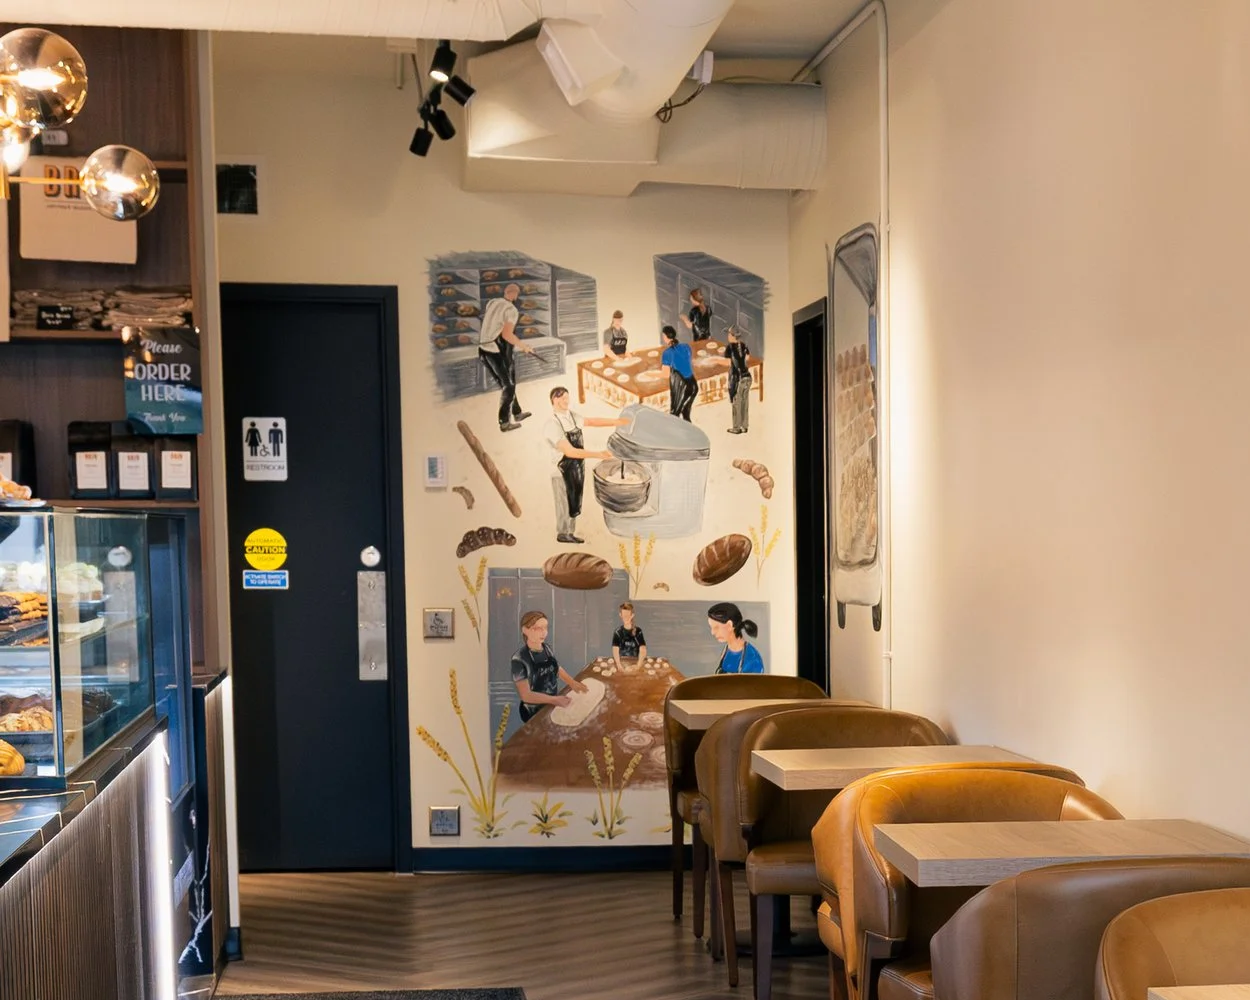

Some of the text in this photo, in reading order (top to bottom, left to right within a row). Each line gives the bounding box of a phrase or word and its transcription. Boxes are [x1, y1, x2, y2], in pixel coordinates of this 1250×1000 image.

[140, 339, 183, 354] Please
[134, 363, 192, 381] ORDER
[140, 384, 186, 402] HERE
[143, 412, 186, 422] Thank You
[245, 546, 286, 554] CAUTION
